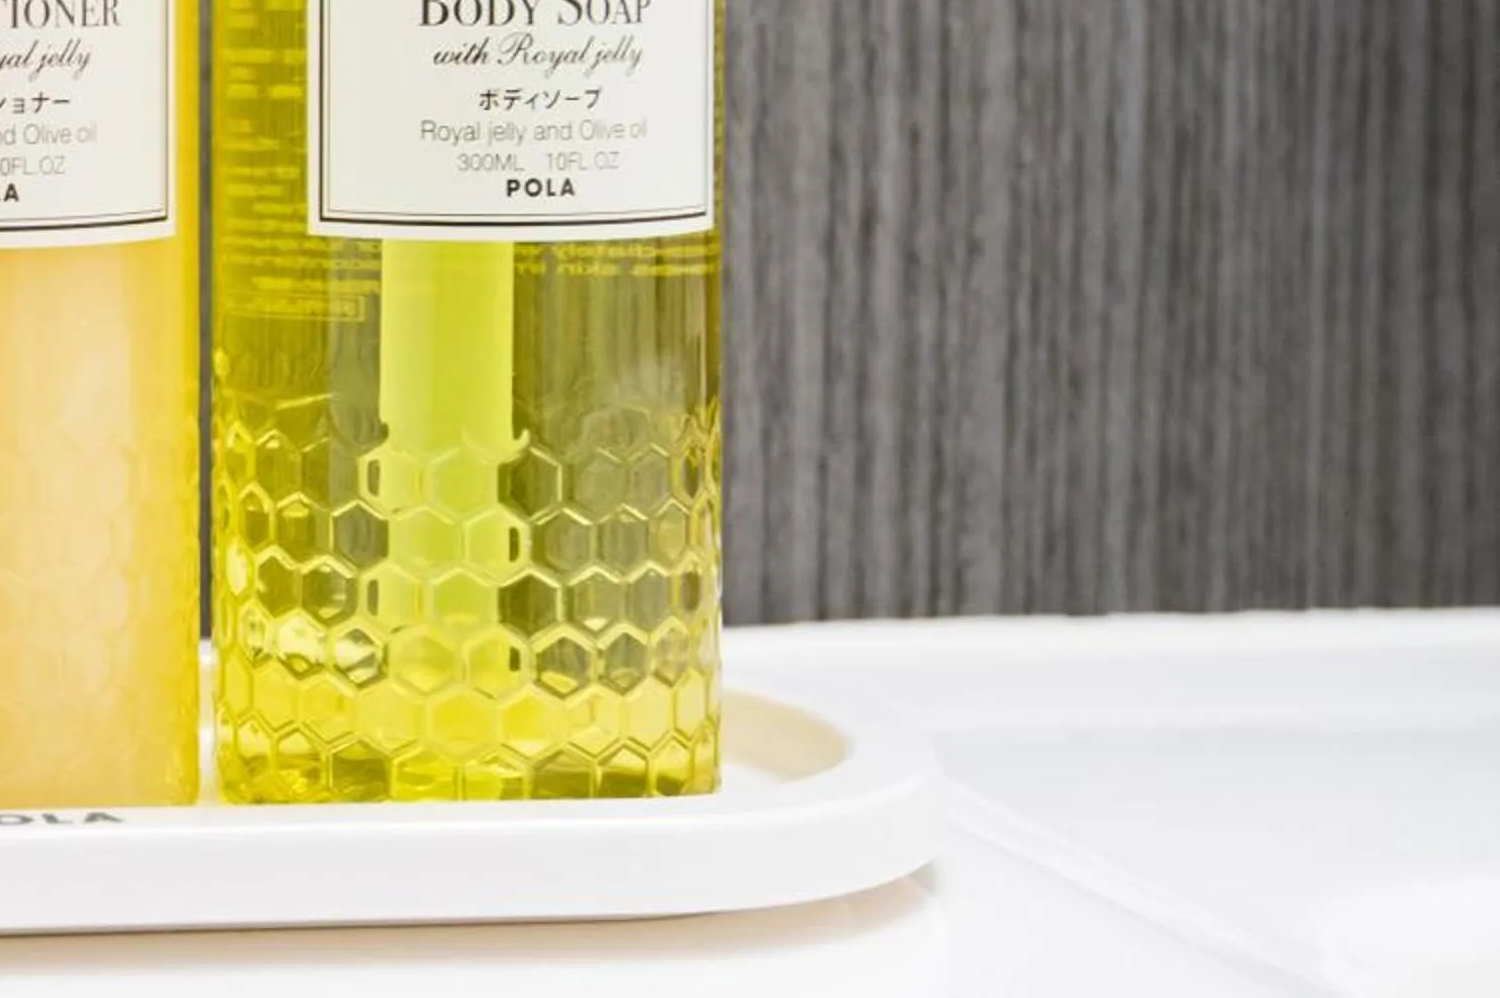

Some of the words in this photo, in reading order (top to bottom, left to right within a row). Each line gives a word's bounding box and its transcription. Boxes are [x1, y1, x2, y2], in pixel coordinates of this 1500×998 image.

[28, 39, 92, 81] jelly
[433, 38, 490, 65] with
[497, 33, 591, 78] Royal
[584, 36, 644, 77] jelly
[23, 123, 73, 145] Olive
[420, 120, 480, 146] Royal
[488, 120, 526, 146] jelly
[534, 120, 572, 141] and
[581, 119, 624, 140] Olive
[457, 153, 525, 172] 300ML
[506, 179, 575, 197] POLA
